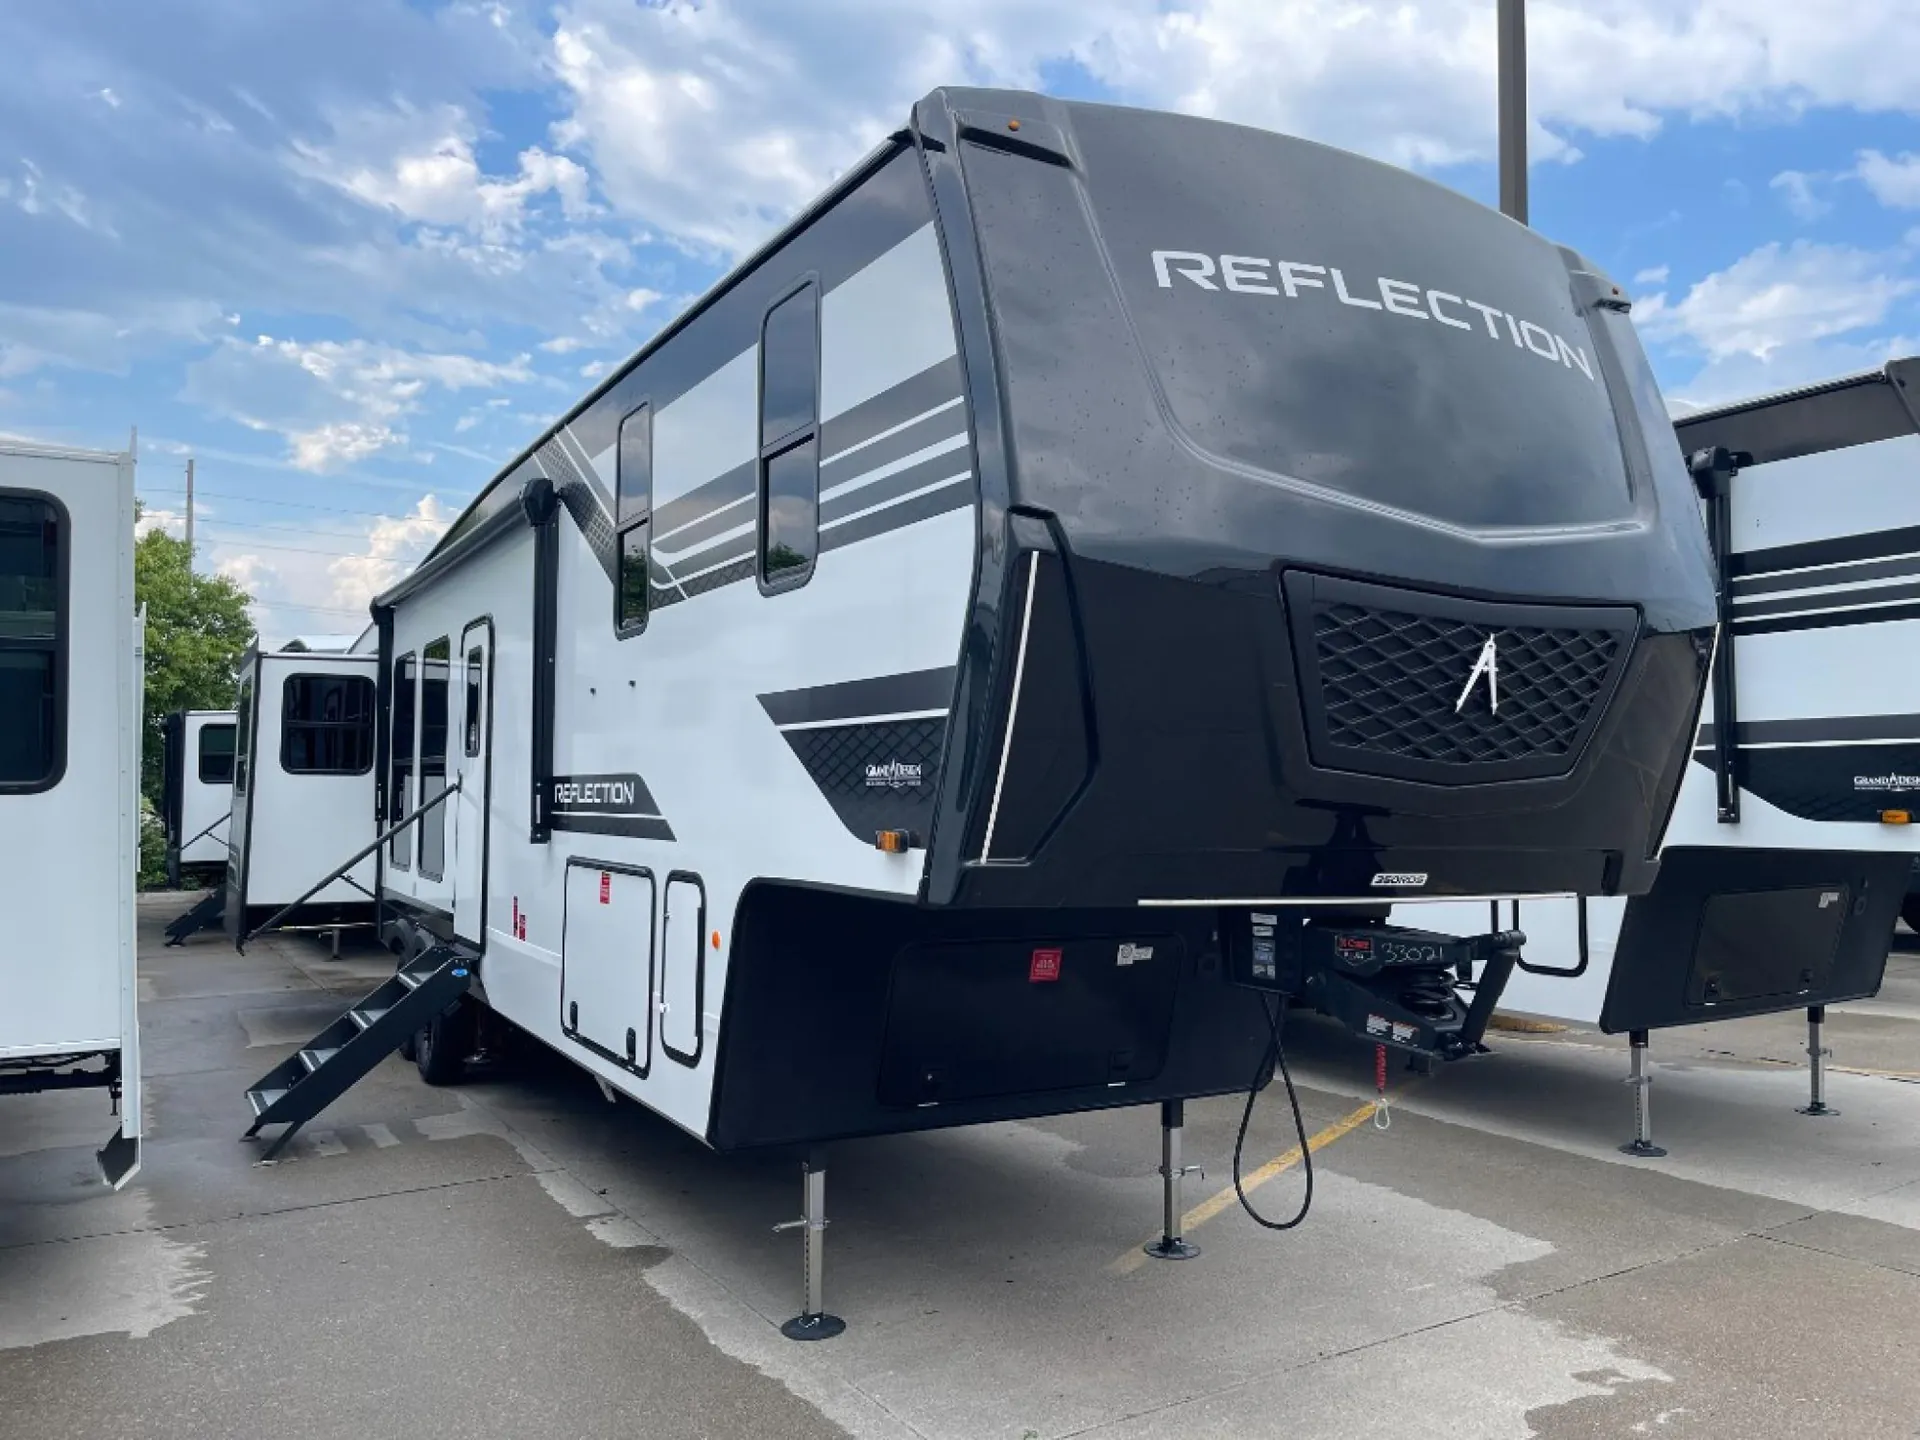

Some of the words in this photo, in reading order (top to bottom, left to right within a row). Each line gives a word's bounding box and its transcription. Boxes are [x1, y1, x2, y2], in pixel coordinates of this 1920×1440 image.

[1151, 249, 1595, 381] REFLECTION
[1854, 775, 1889, 785] GRAND
[554, 782, 635, 805] REFLECTION
